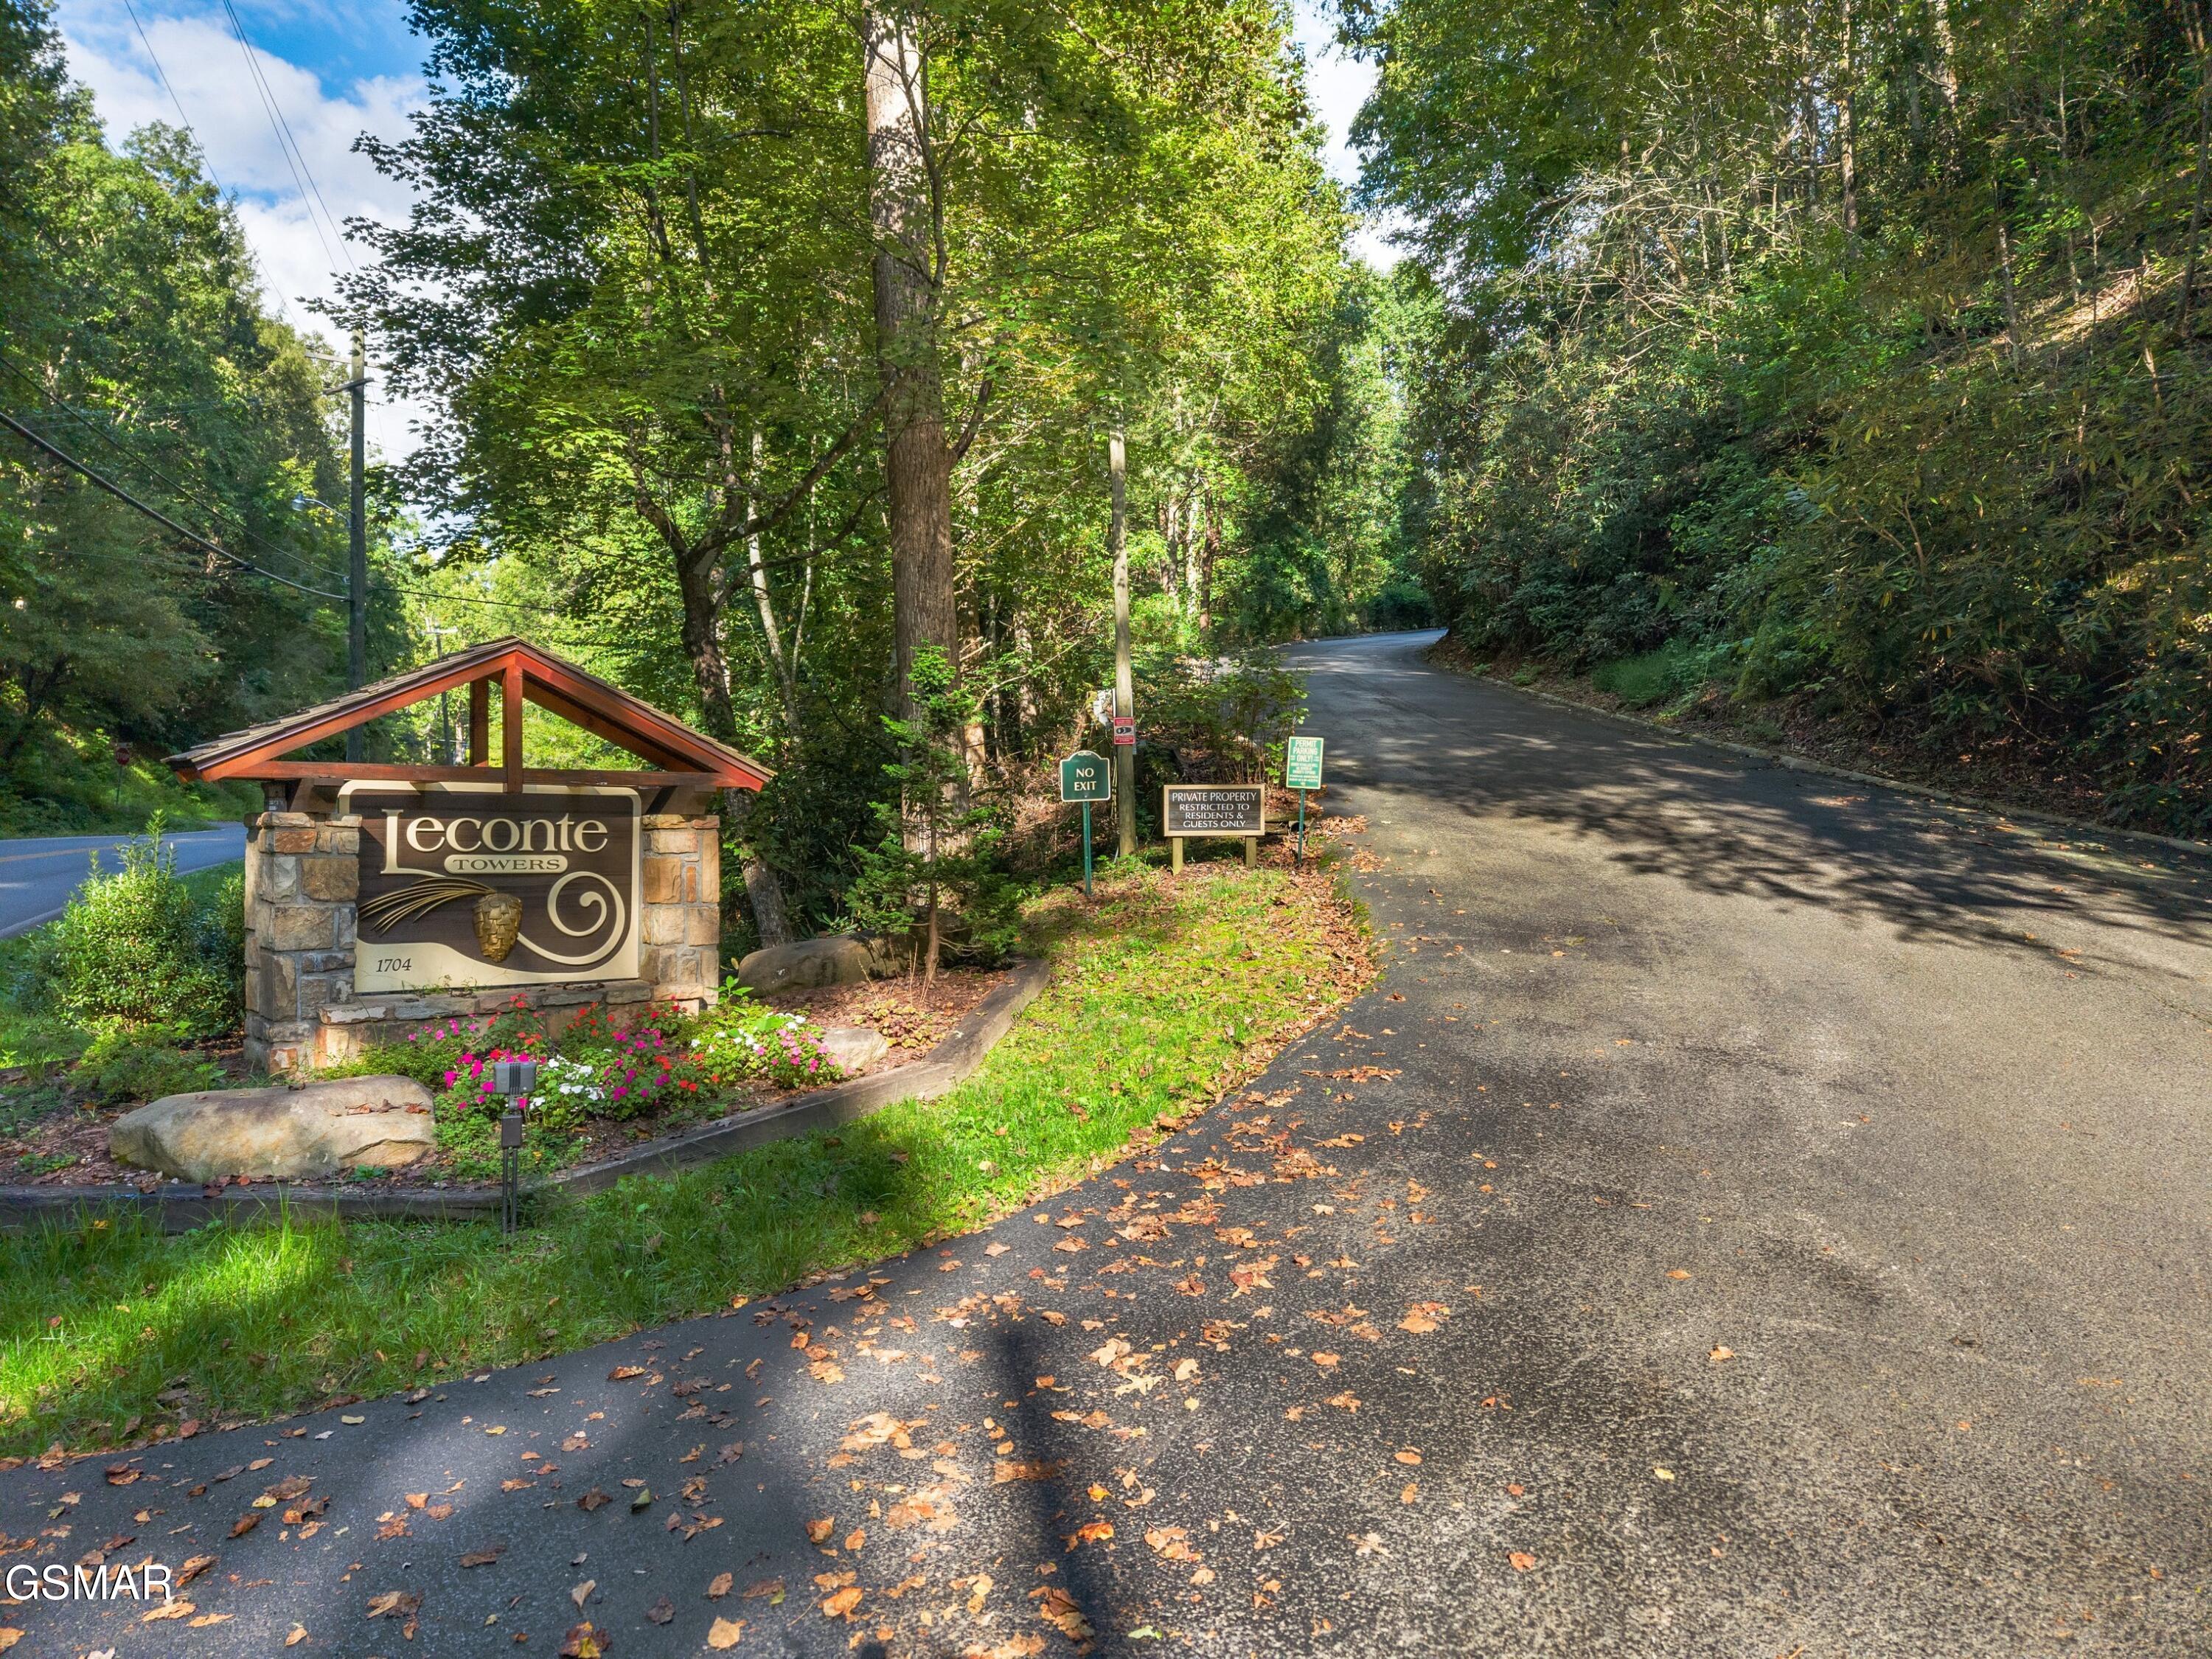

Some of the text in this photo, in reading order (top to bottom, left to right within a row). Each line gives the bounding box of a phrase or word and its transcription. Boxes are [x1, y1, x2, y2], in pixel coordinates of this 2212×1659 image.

[1295, 740, 1317, 748] PERMIT
[1293, 747, 1318, 755] PARKING
[116, 752, 130, 760] STOP
[1076, 768, 1094, 778] NO
[1074, 781, 1097, 791] EXIT
[1172, 792, 1256, 801] PRIVATE PROPERTY
[1179, 803, 1234, 811] RESTRICTED
[1183, 820, 1218, 828] GUESTS
[380, 809, 608, 877] Leconte
[453, 859, 560, 870] TOWERS
[376, 958, 411, 972] 1704
